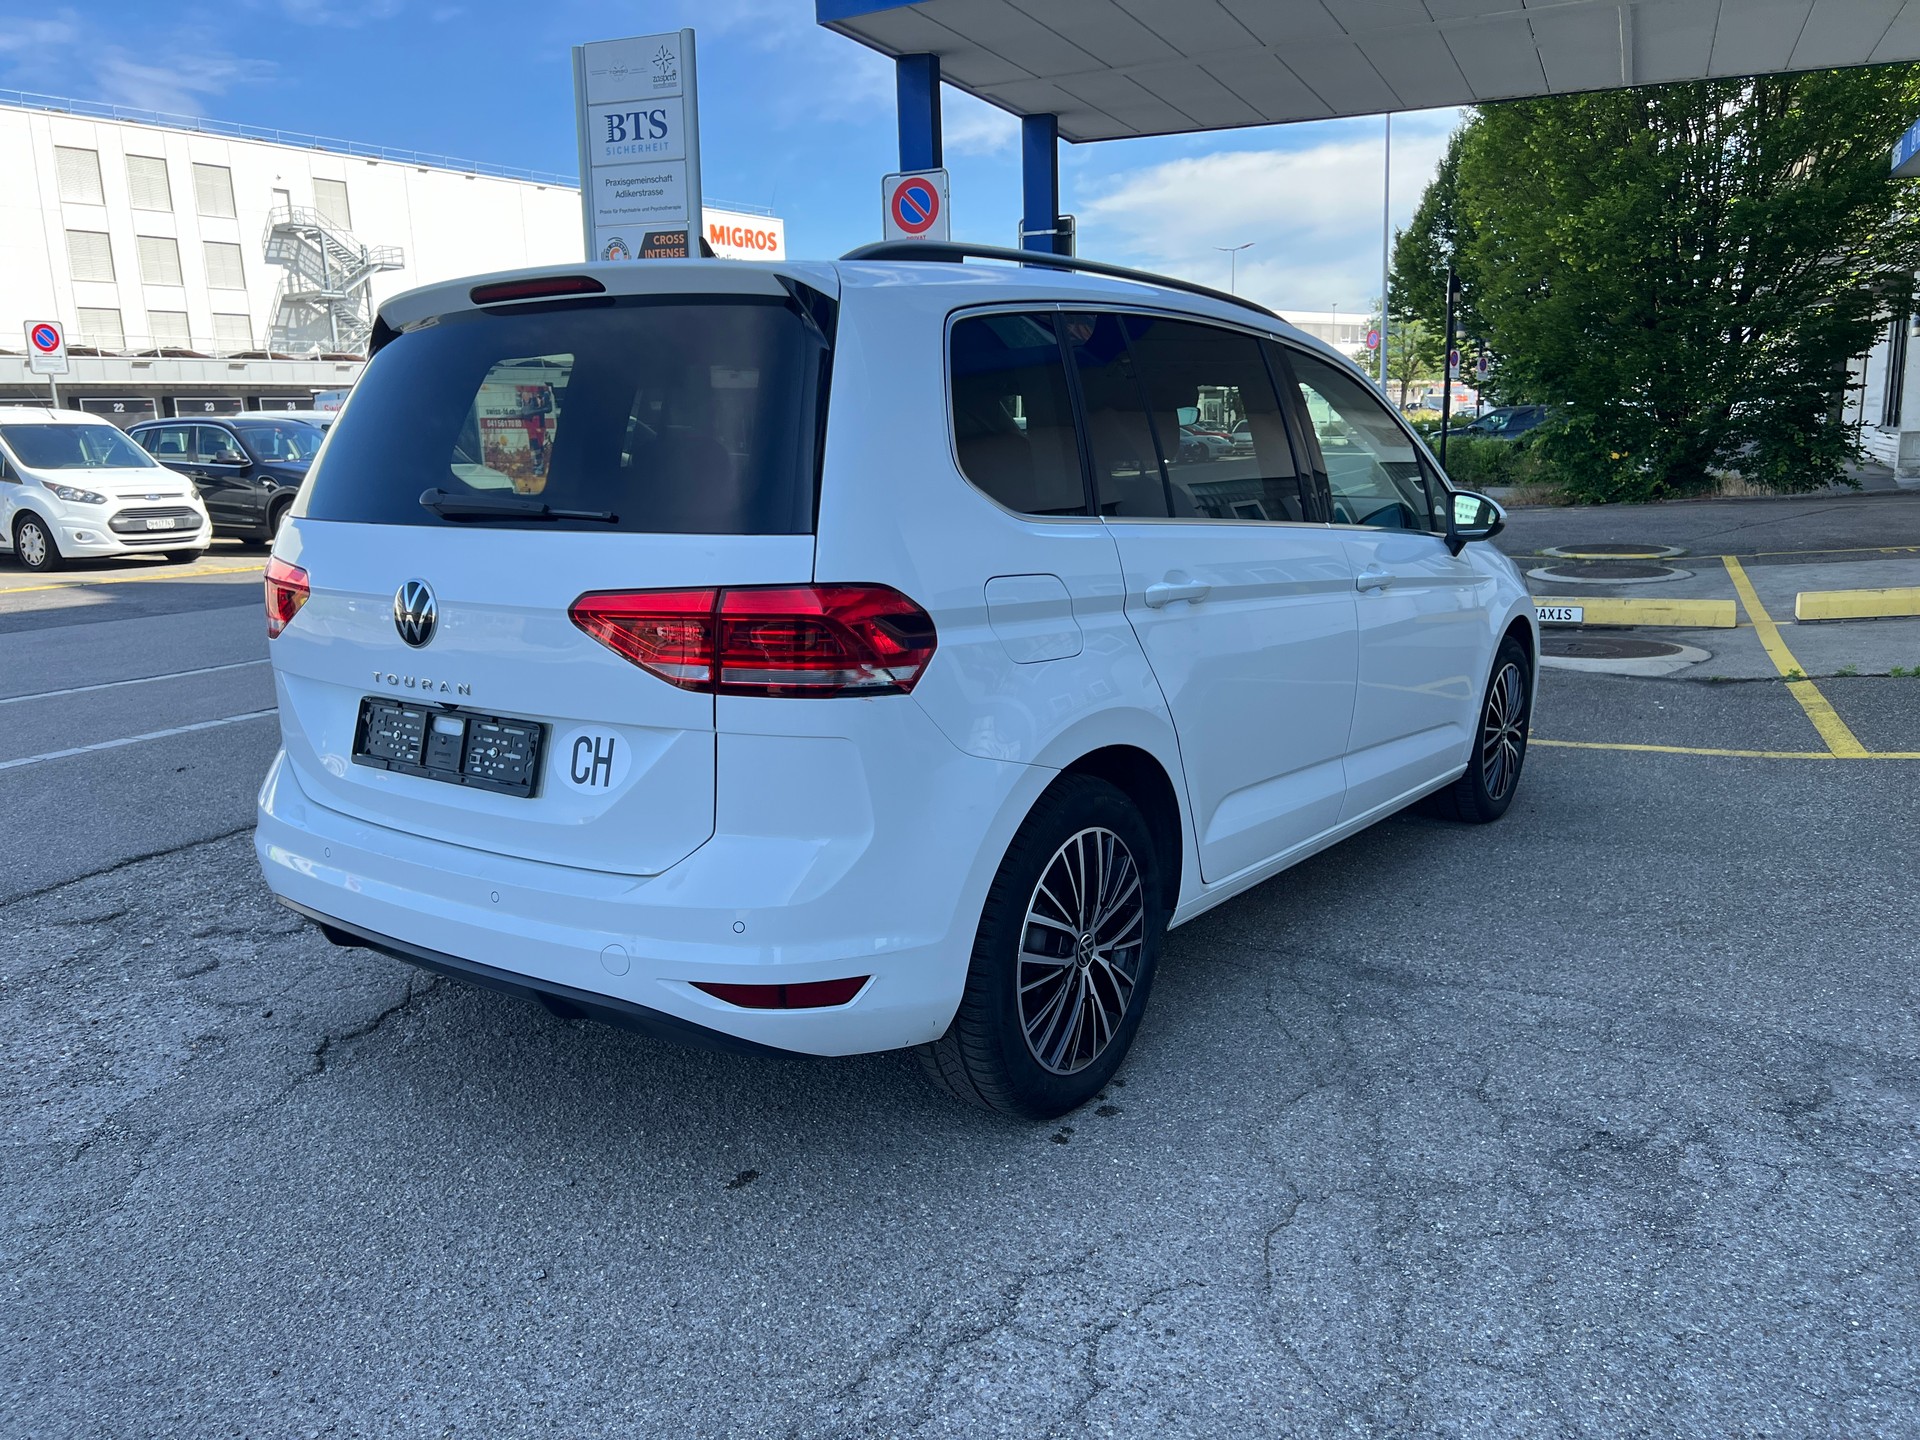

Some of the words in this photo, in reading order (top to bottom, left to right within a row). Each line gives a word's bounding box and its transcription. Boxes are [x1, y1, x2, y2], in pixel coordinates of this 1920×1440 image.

[604, 109, 668, 144] BTS
[606, 142, 669, 156] SICHERHEIT
[605, 174, 673, 187] Praxisgemeinschaft
[615, 188, 664, 199] Adlikerstrasse
[653, 233, 685, 246] CROSS
[709, 224, 778, 252] MIGROS
[644, 247, 686, 259] INTENSE
[113, 403, 125, 412] 22
[204, 402, 215, 412] 23
[287, 402, 296, 411] 24
[1535, 608, 1572, 620] AXIS
[371, 670, 473, 697] TOURAN
[569, 735, 616, 788] CH
